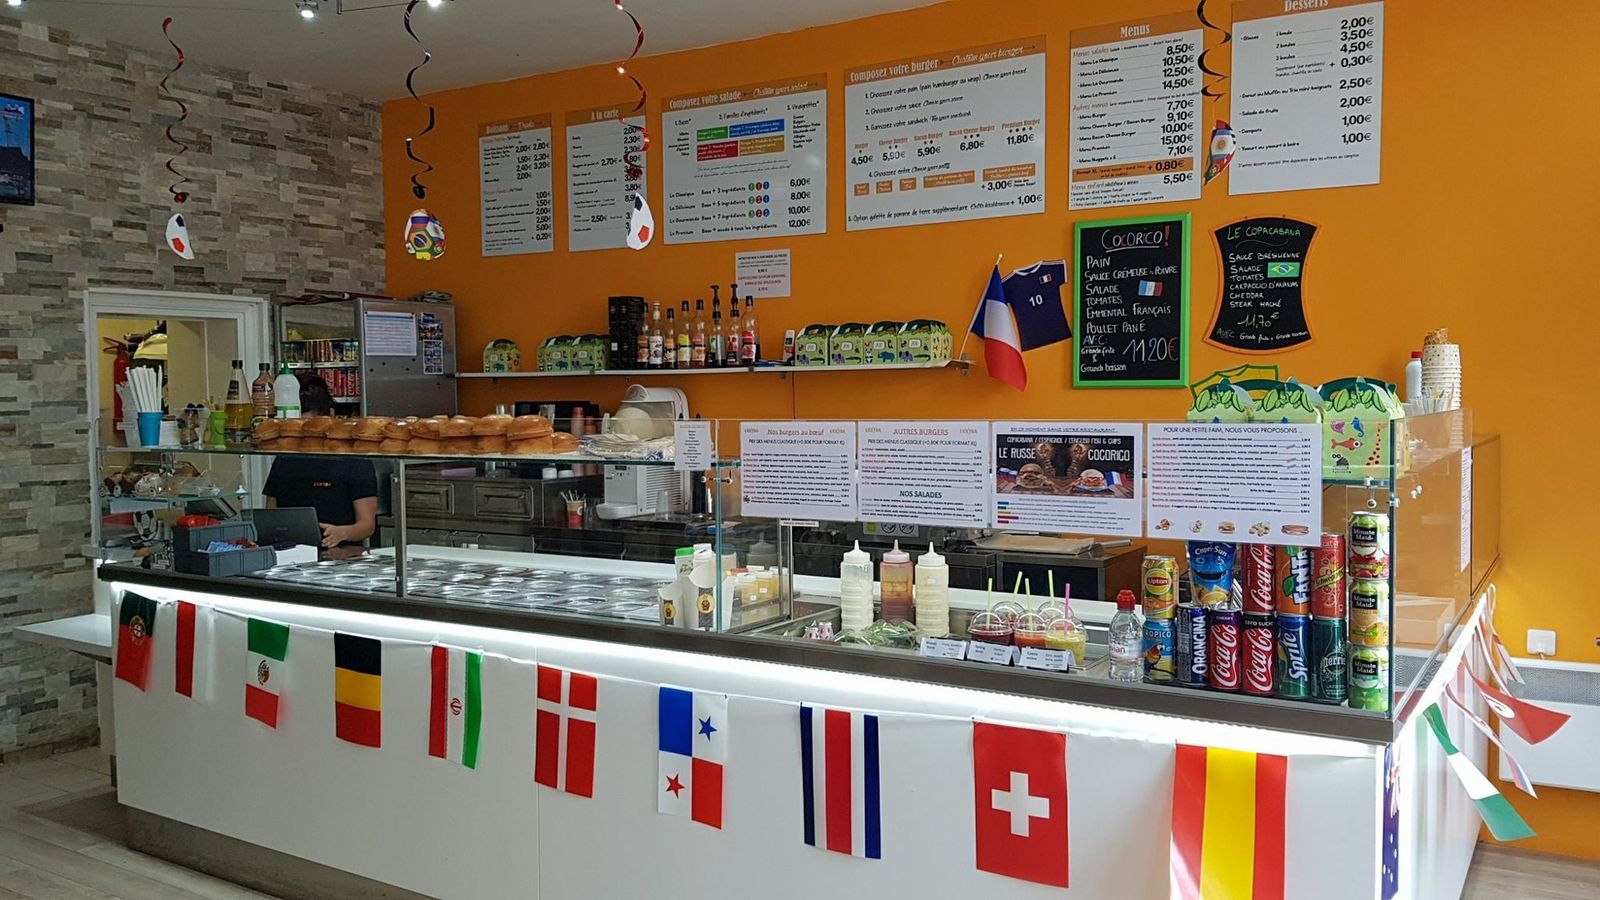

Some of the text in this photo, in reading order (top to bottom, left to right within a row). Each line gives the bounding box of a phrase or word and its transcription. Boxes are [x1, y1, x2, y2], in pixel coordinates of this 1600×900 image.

[1284, 0, 1328, 12] Desserts
[1340, 16, 1374, 30] 2,00€
[1120, 24, 1150, 39] Menus
[1340, 28, 1374, 42] 3,50€
[1166, 44, 1194, 56] 8,50€
[1340, 40, 1374, 54] 4,50€
[1162, 55, 1194, 67] 10,50€
[1340, 55, 1374, 68] 0,30€
[850, 67, 888, 82] Composez
[890, 62, 910, 75] votre
[912, 58, 940, 72] burger
[1162, 66, 1194, 78] 12,50€
[1162, 78, 1194, 90] 14,50€
[1340, 77, 1372, 90] 2,50€
[670, 98, 700, 109] Composez
[702, 94, 719, 104] votre
[720, 90, 741, 101] salade
[1167, 100, 1194, 111] 7,70€
[1340, 96, 1372, 109] 2,00€
[1167, 110, 1194, 122] 9,10€
[1342, 114, 1372, 127] 1,00€
[1161, 122, 1194, 134] 10,00€
[1006, 134, 1034, 145] 11,80€
[1160, 134, 1194, 145] 15,00€
[1341, 132, 1372, 144] 1,00€
[960, 140, 984, 151] 6,80€
[1168, 146, 1194, 156] 7,10€
[918, 146, 941, 158] 5,90€
[851, 154, 874, 166] 4,50€
[1156, 160, 1185, 171] 0,80€
[790, 178, 811, 188] 6,00€
[1164, 173, 1193, 184] 5,50€
[987, 180, 1012, 191] 3,00€
[790, 192, 811, 200] 8,00€
[1018, 194, 1042, 205] 1,00€
[788, 206, 811, 214] 10,00€
[788, 218, 811, 228] 12,00€
[1227, 226, 1300, 240] LE COPACABANA
[1086, 256, 1111, 269] PAIN
[1228, 252, 1254, 264] SAUCE
[1085, 272, 1110, 284] SAUCE
[1154, 266, 1178, 276] POIVRE
[1230, 264, 1262, 274] SALADE
[1230, 274, 1264, 282] TOMATES
[1086, 284, 1120, 296] SALADE
[1029, 295, 1043, 307] 10
[1085, 296, 1122, 306] TOMATES
[1230, 300, 1253, 308] STEAK
[1086, 303, 1172, 320] EMMENTAL FRANÇAIS
[1086, 319, 1146, 334] POULET PANÉ
[1122, 336, 1178, 365] 11,20€
[894, 428, 948, 436] AUTRES BURGERS
[998, 447, 1036, 460] LE RUSSE
[1088, 449, 1130, 462] COCORICO
[900, 490, 942, 498] NOS SALADES
[1354, 528, 1376, 536] Minute
[1148, 578, 1168, 586] Lipton
[1354, 596, 1376, 604] Minute
[1192, 616, 1207, 675] ORANGINA
[1281, 632, 1308, 682] Sprite
[1354, 662, 1376, 670] Minute
